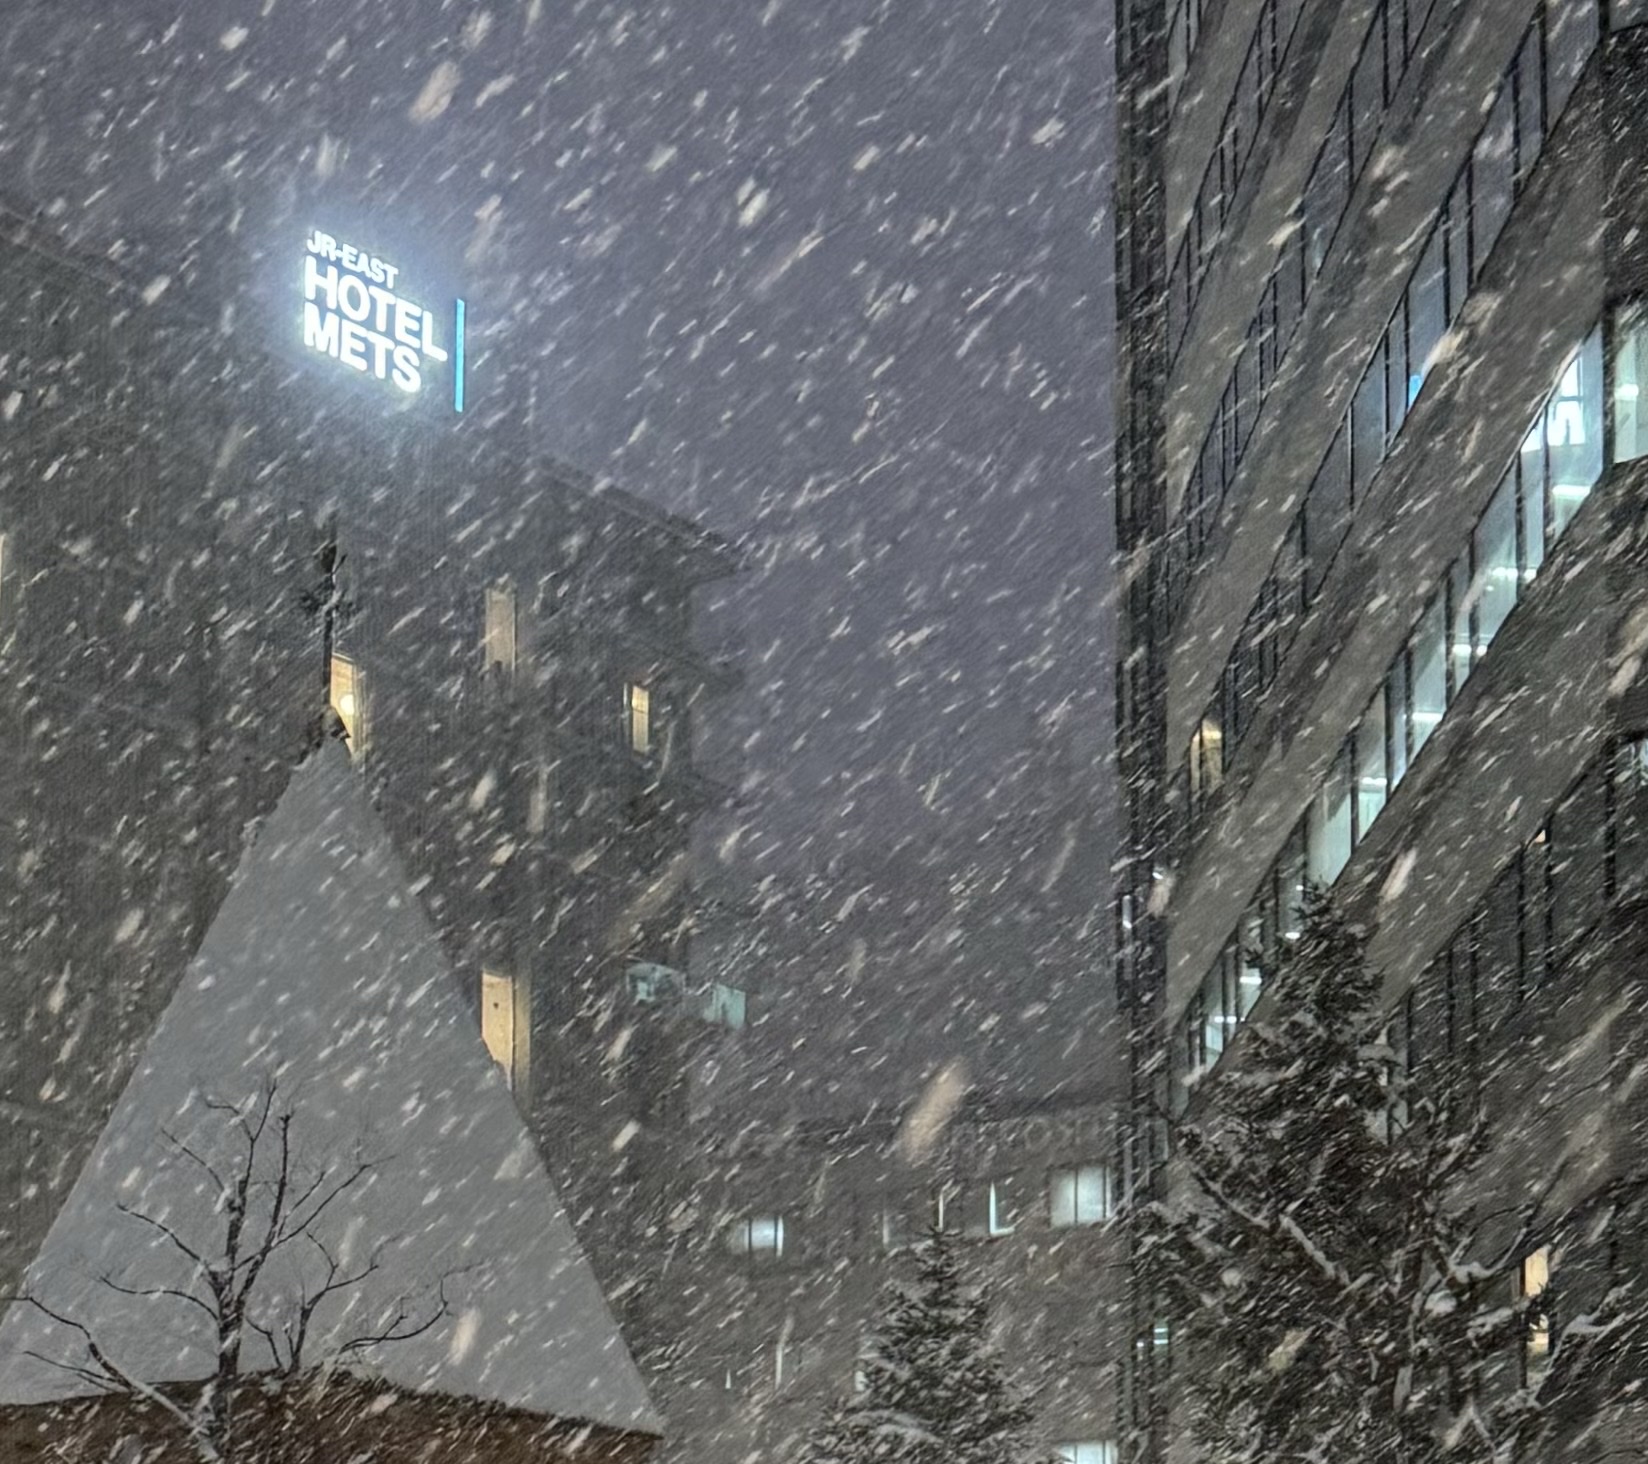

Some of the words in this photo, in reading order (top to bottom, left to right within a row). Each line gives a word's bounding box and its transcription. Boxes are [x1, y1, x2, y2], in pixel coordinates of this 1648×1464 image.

[306, 230, 399, 289] JR-EAST
[304, 255, 448, 362] HOTEL
[304, 301, 422, 393] METS
